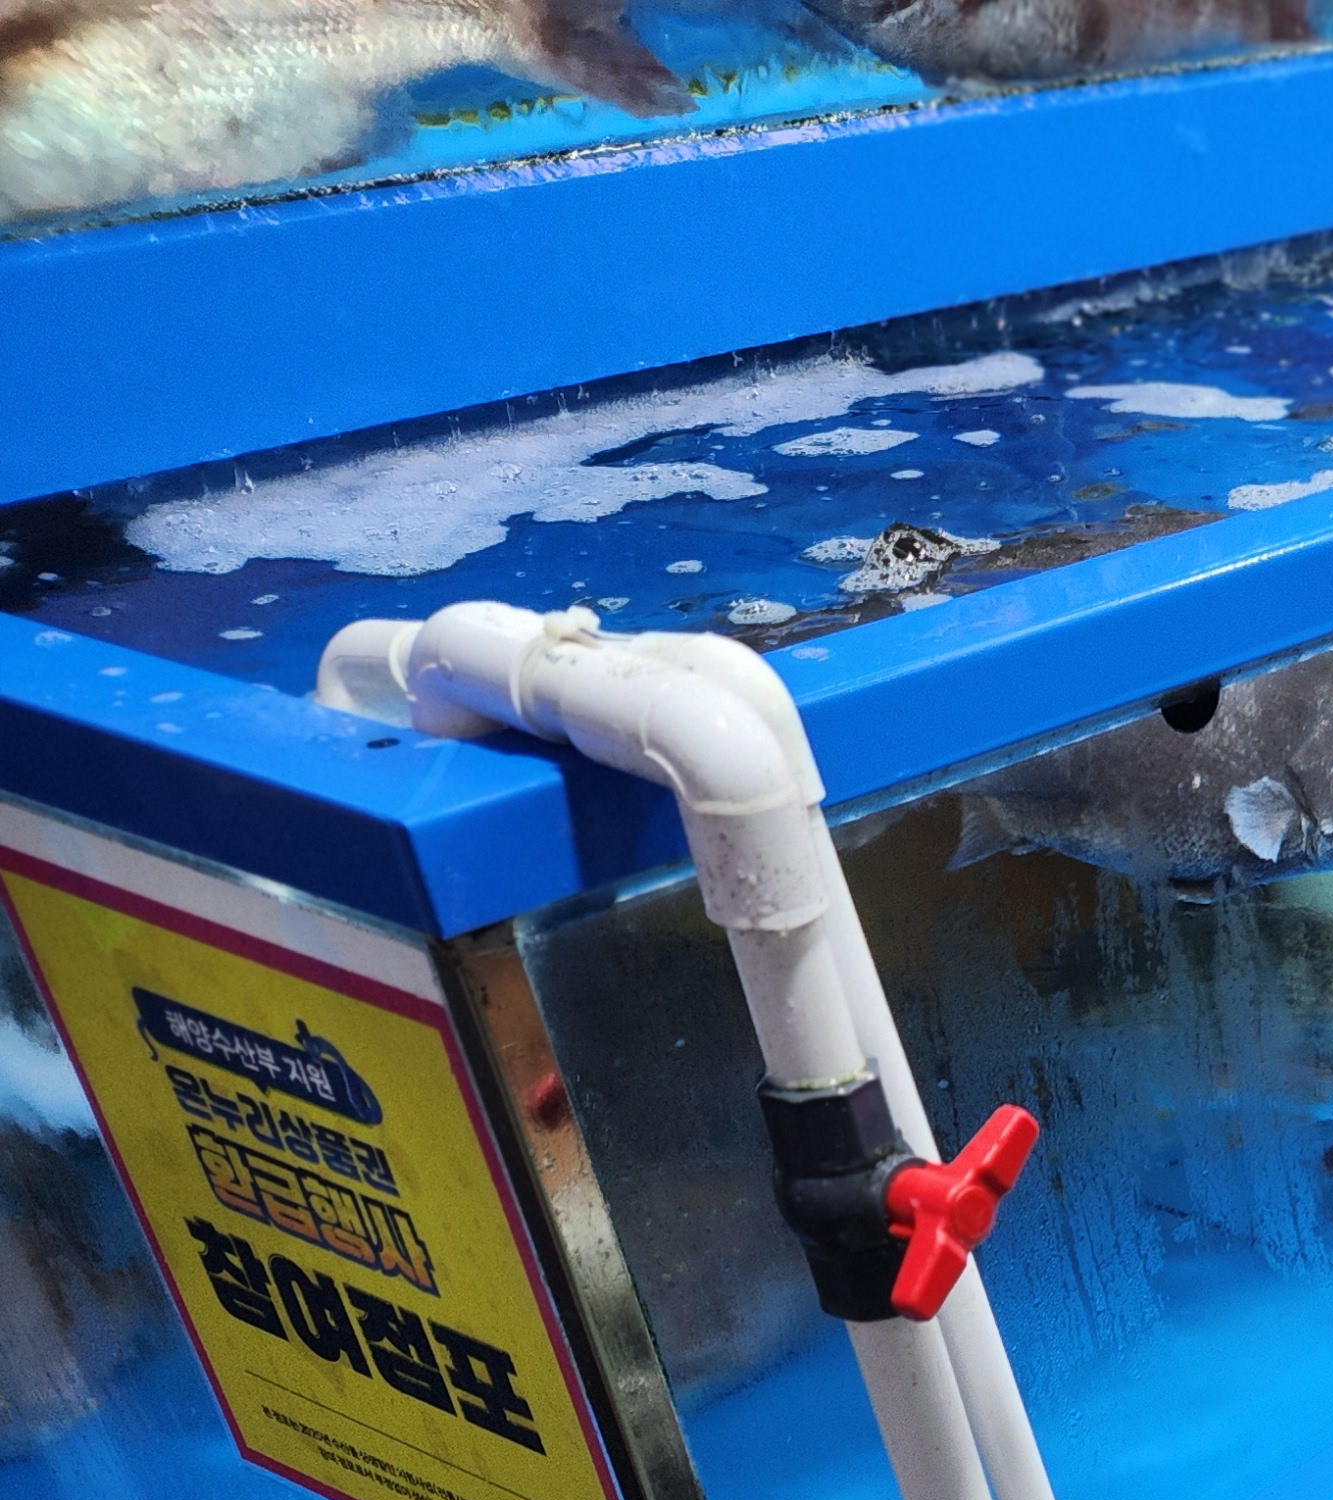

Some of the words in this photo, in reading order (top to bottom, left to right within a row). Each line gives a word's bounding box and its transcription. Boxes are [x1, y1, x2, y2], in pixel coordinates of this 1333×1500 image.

[165, 1010, 281, 1080] 해양수산부
[282, 1057, 337, 1102] 지원
[165, 1065, 400, 1198] 온누리상품권
[185, 1122, 441, 1298] 환급행사
[183, 1216, 547, 1457] 참여점포
